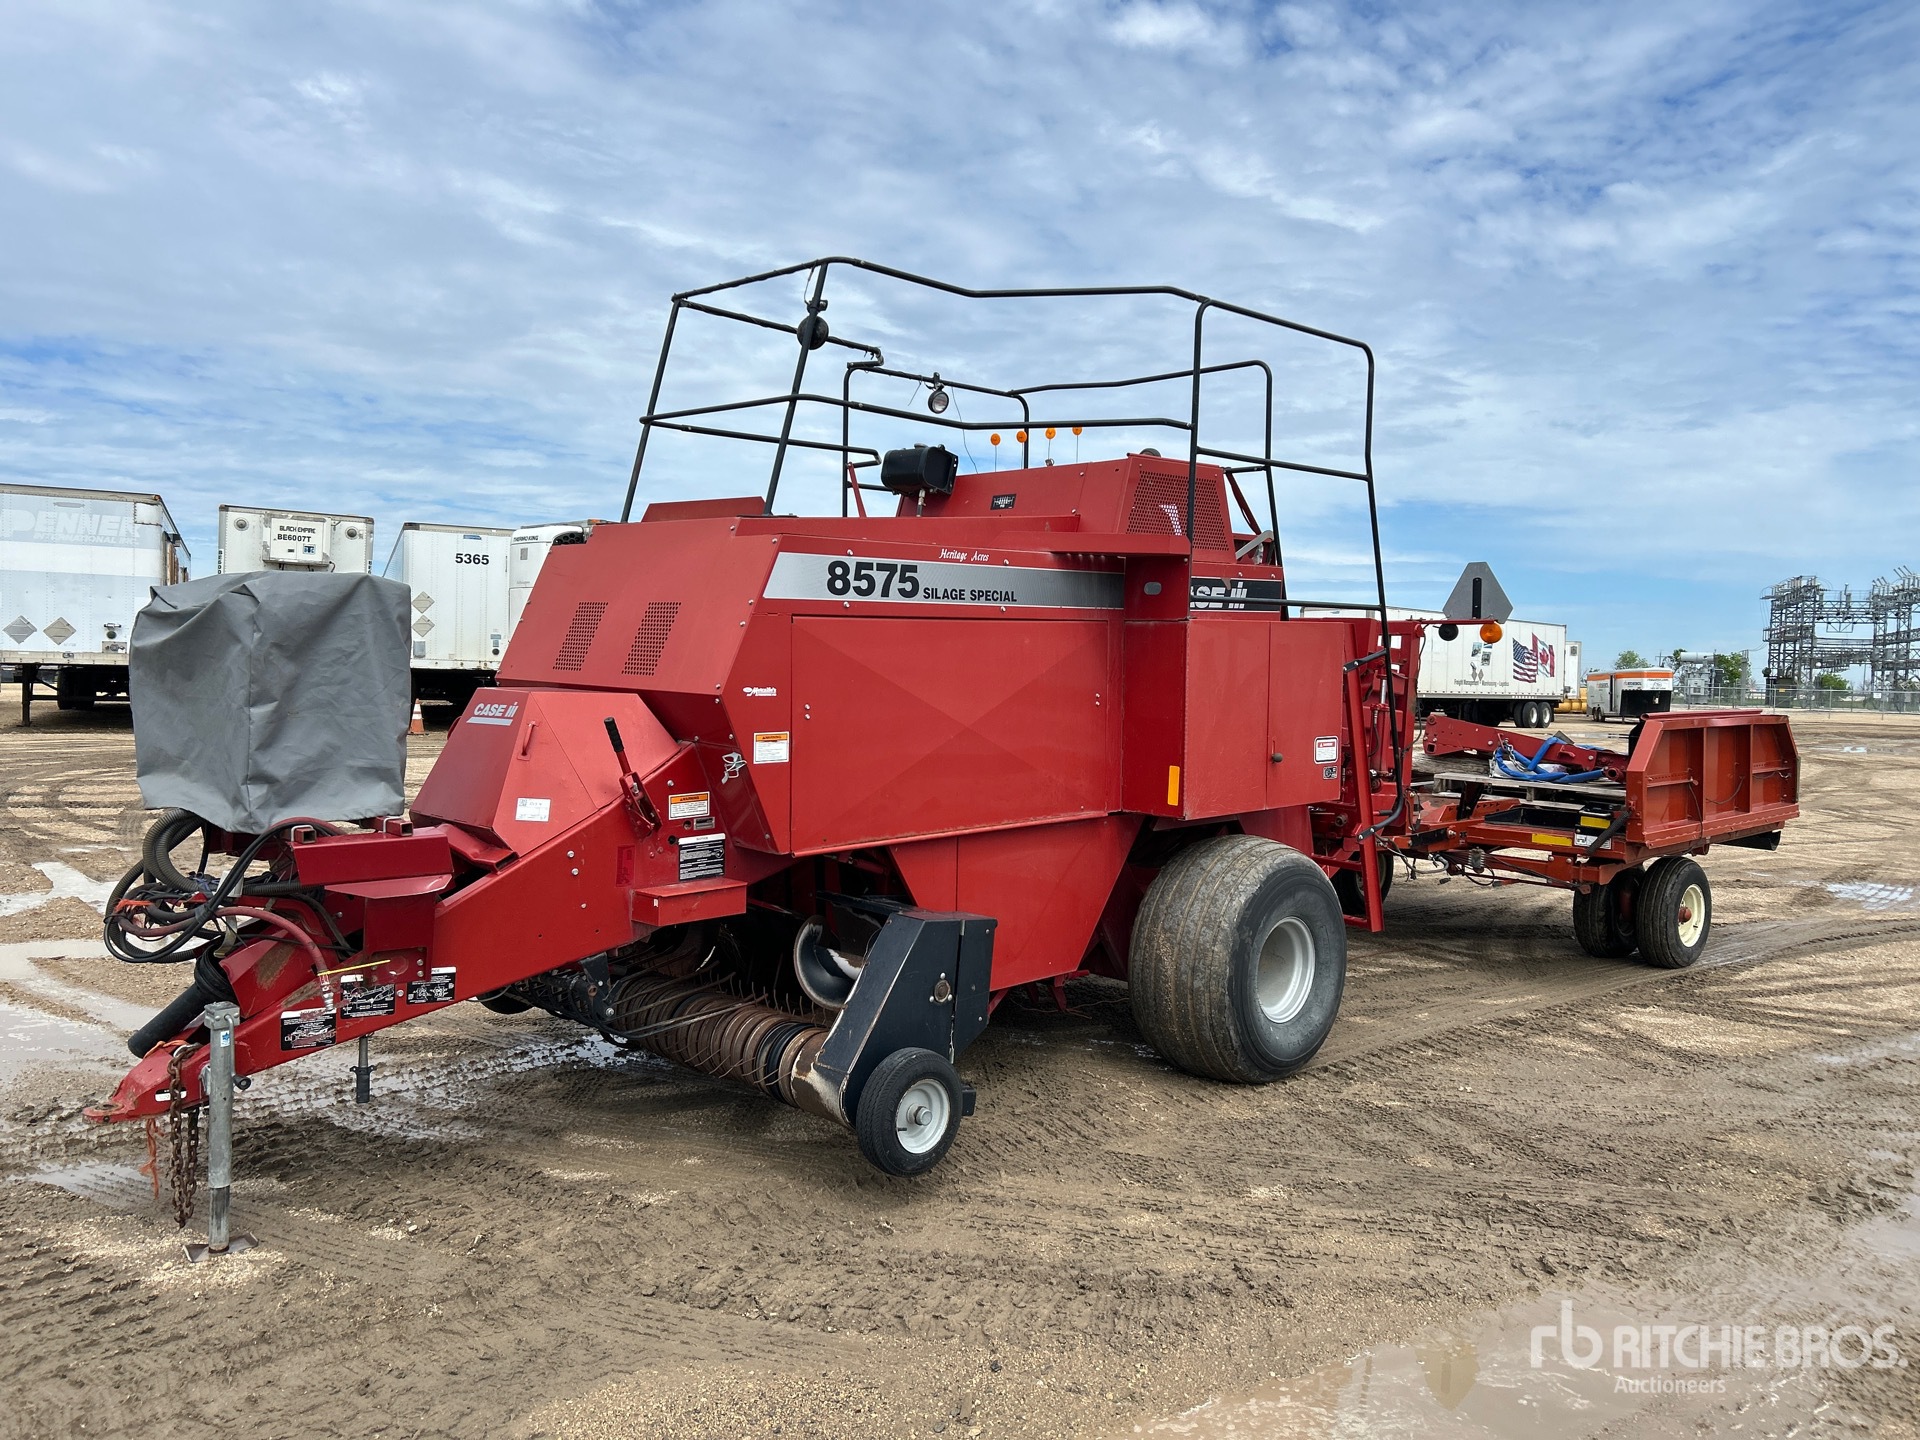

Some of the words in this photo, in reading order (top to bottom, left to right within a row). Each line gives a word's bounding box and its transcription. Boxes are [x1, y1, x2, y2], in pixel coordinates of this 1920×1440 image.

[2, 508, 141, 538] PENNER
[279, 525, 297, 533] BLACK
[277, 533, 311, 543] BE6007T
[455, 553, 490, 565] 5365
[938, 548, 968, 563] Heritage
[970, 550, 990, 562] Acres
[826, 560, 920, 599] 8575
[922, 586, 966, 601] SILAGE
[969, 589, 1018, 602] SPECIAL
[473, 703, 508, 717] CASE
